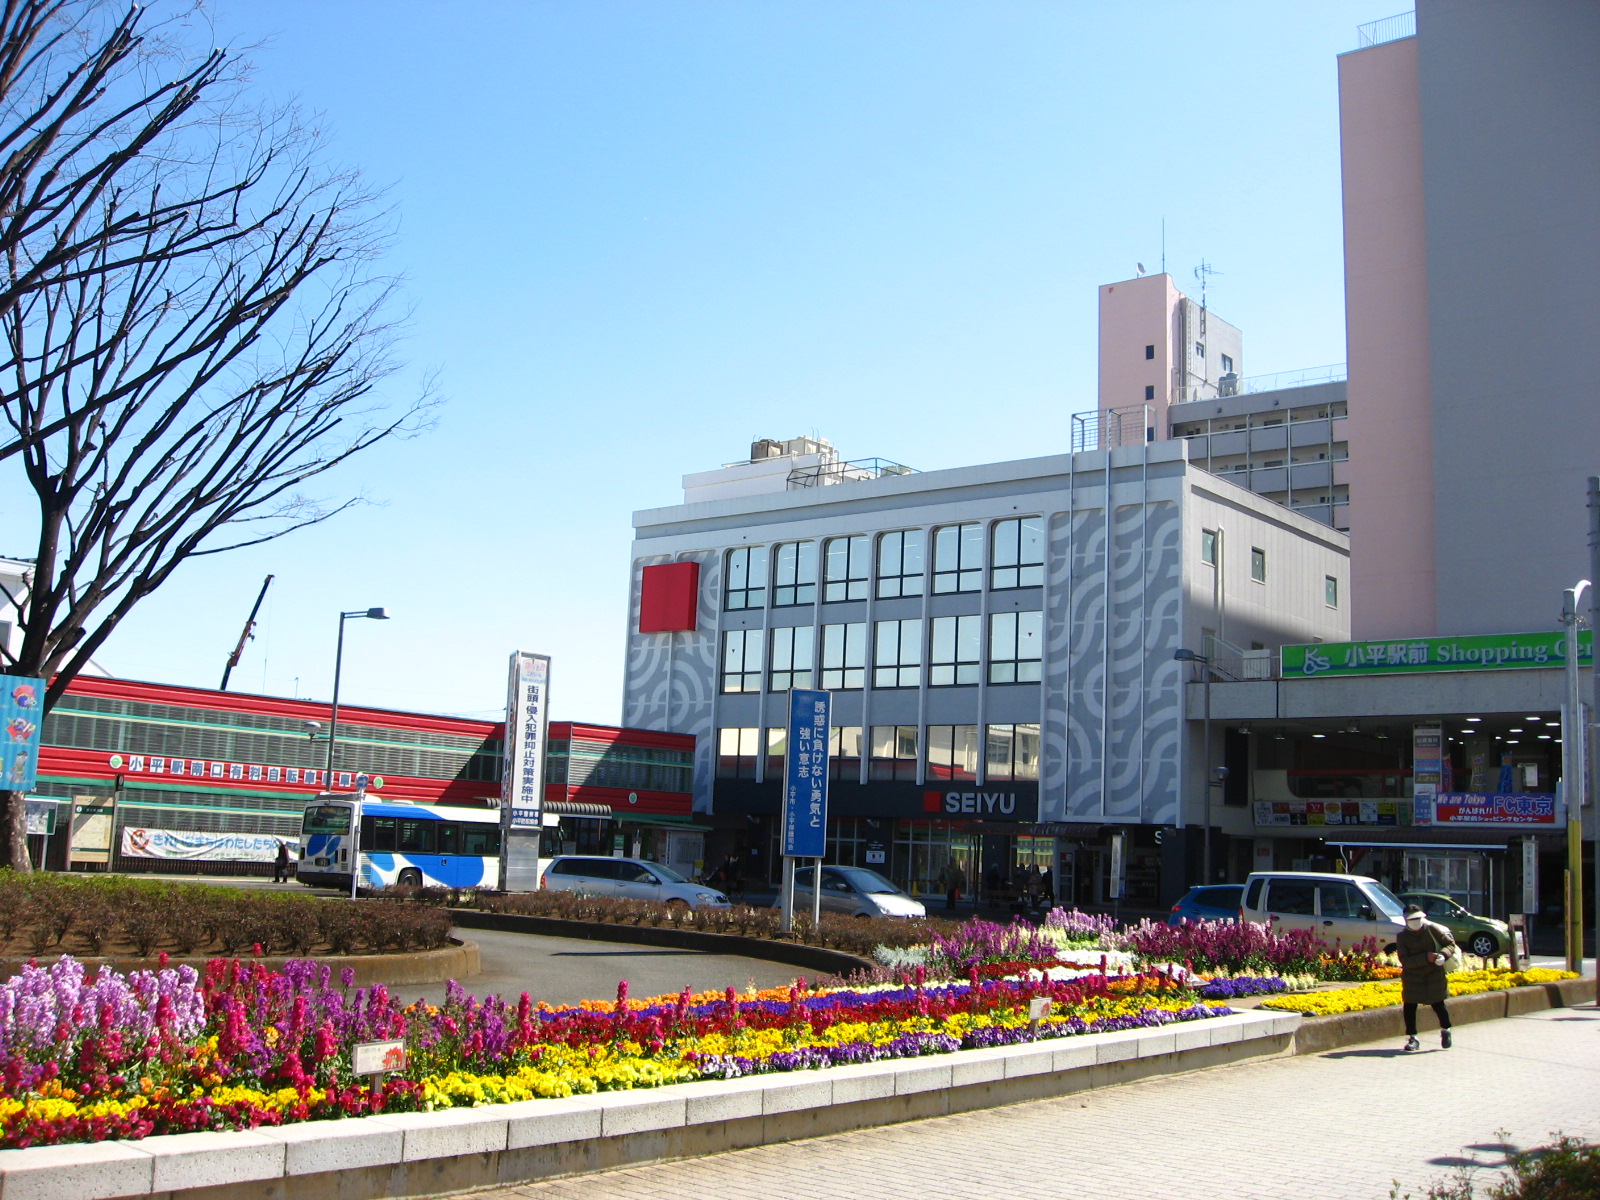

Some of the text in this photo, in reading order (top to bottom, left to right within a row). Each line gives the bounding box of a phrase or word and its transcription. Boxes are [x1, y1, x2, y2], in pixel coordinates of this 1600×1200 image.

[1344, 643, 1429, 667] 小平駅前
[1437, 640, 1549, 665] Shopping
[798, 727, 811, 778] 強い意志
[810, 701, 826, 828] 誘惑に負けない勇気と
[130, 757, 352, 787] 小平駅南口有料自転車車
[945, 792, 1016, 814] SEIYU
[1437, 794, 1486, 806] We are Tokyo
[1493, 795, 1553, 815] FC東京
